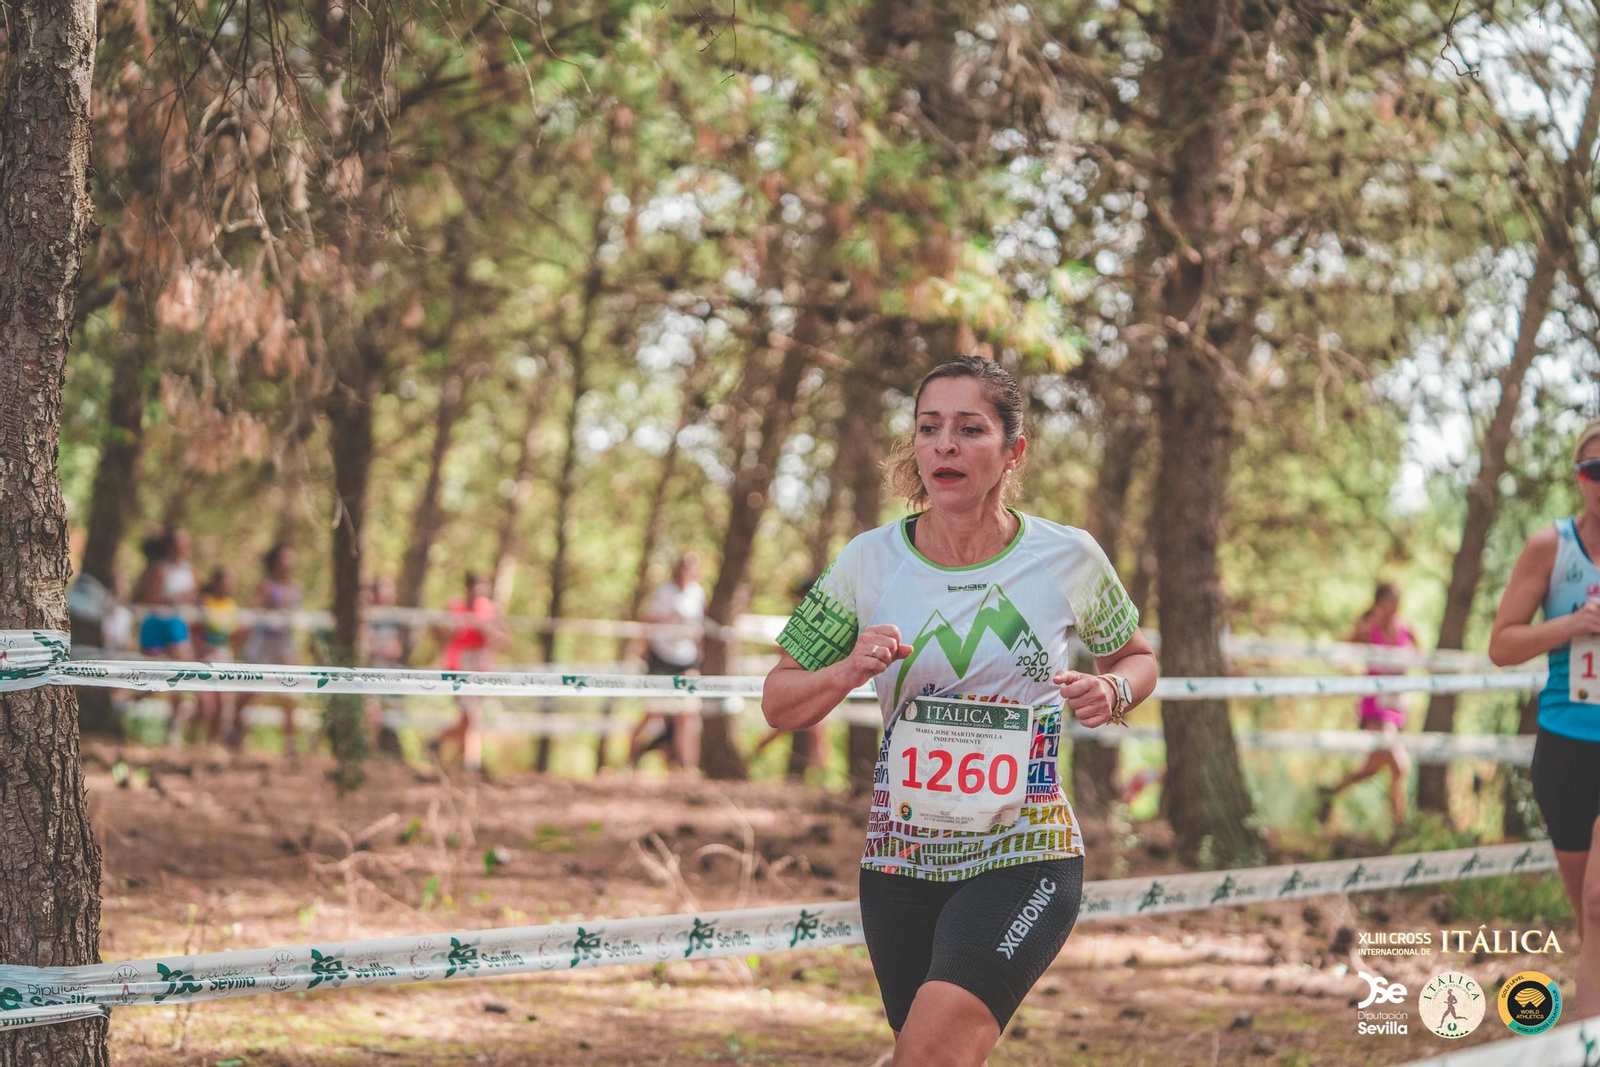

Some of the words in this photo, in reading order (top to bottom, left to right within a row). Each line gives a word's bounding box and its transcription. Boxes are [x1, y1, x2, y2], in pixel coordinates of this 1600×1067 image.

[1016, 652, 1048, 666] 2020
[1022, 667, 1052, 682] 2025
[926, 704, 993, 724] ITÁLICA
[915, 727, 934, 735] MARIA
[951, 730, 975, 738] MARTIN
[976, 732, 1003, 740] BONILLA
[933, 736, 982, 745] INDEPENDIENTE
[902, 747, 1018, 795] 1260
[820, 921, 853, 938] Sevilla
[717, 930, 751, 948] Sevilla
[604, 940, 643, 958] Sevilla
[481, 950, 525, 968] Sevilla
[348, 962, 397, 979] Sevilla
